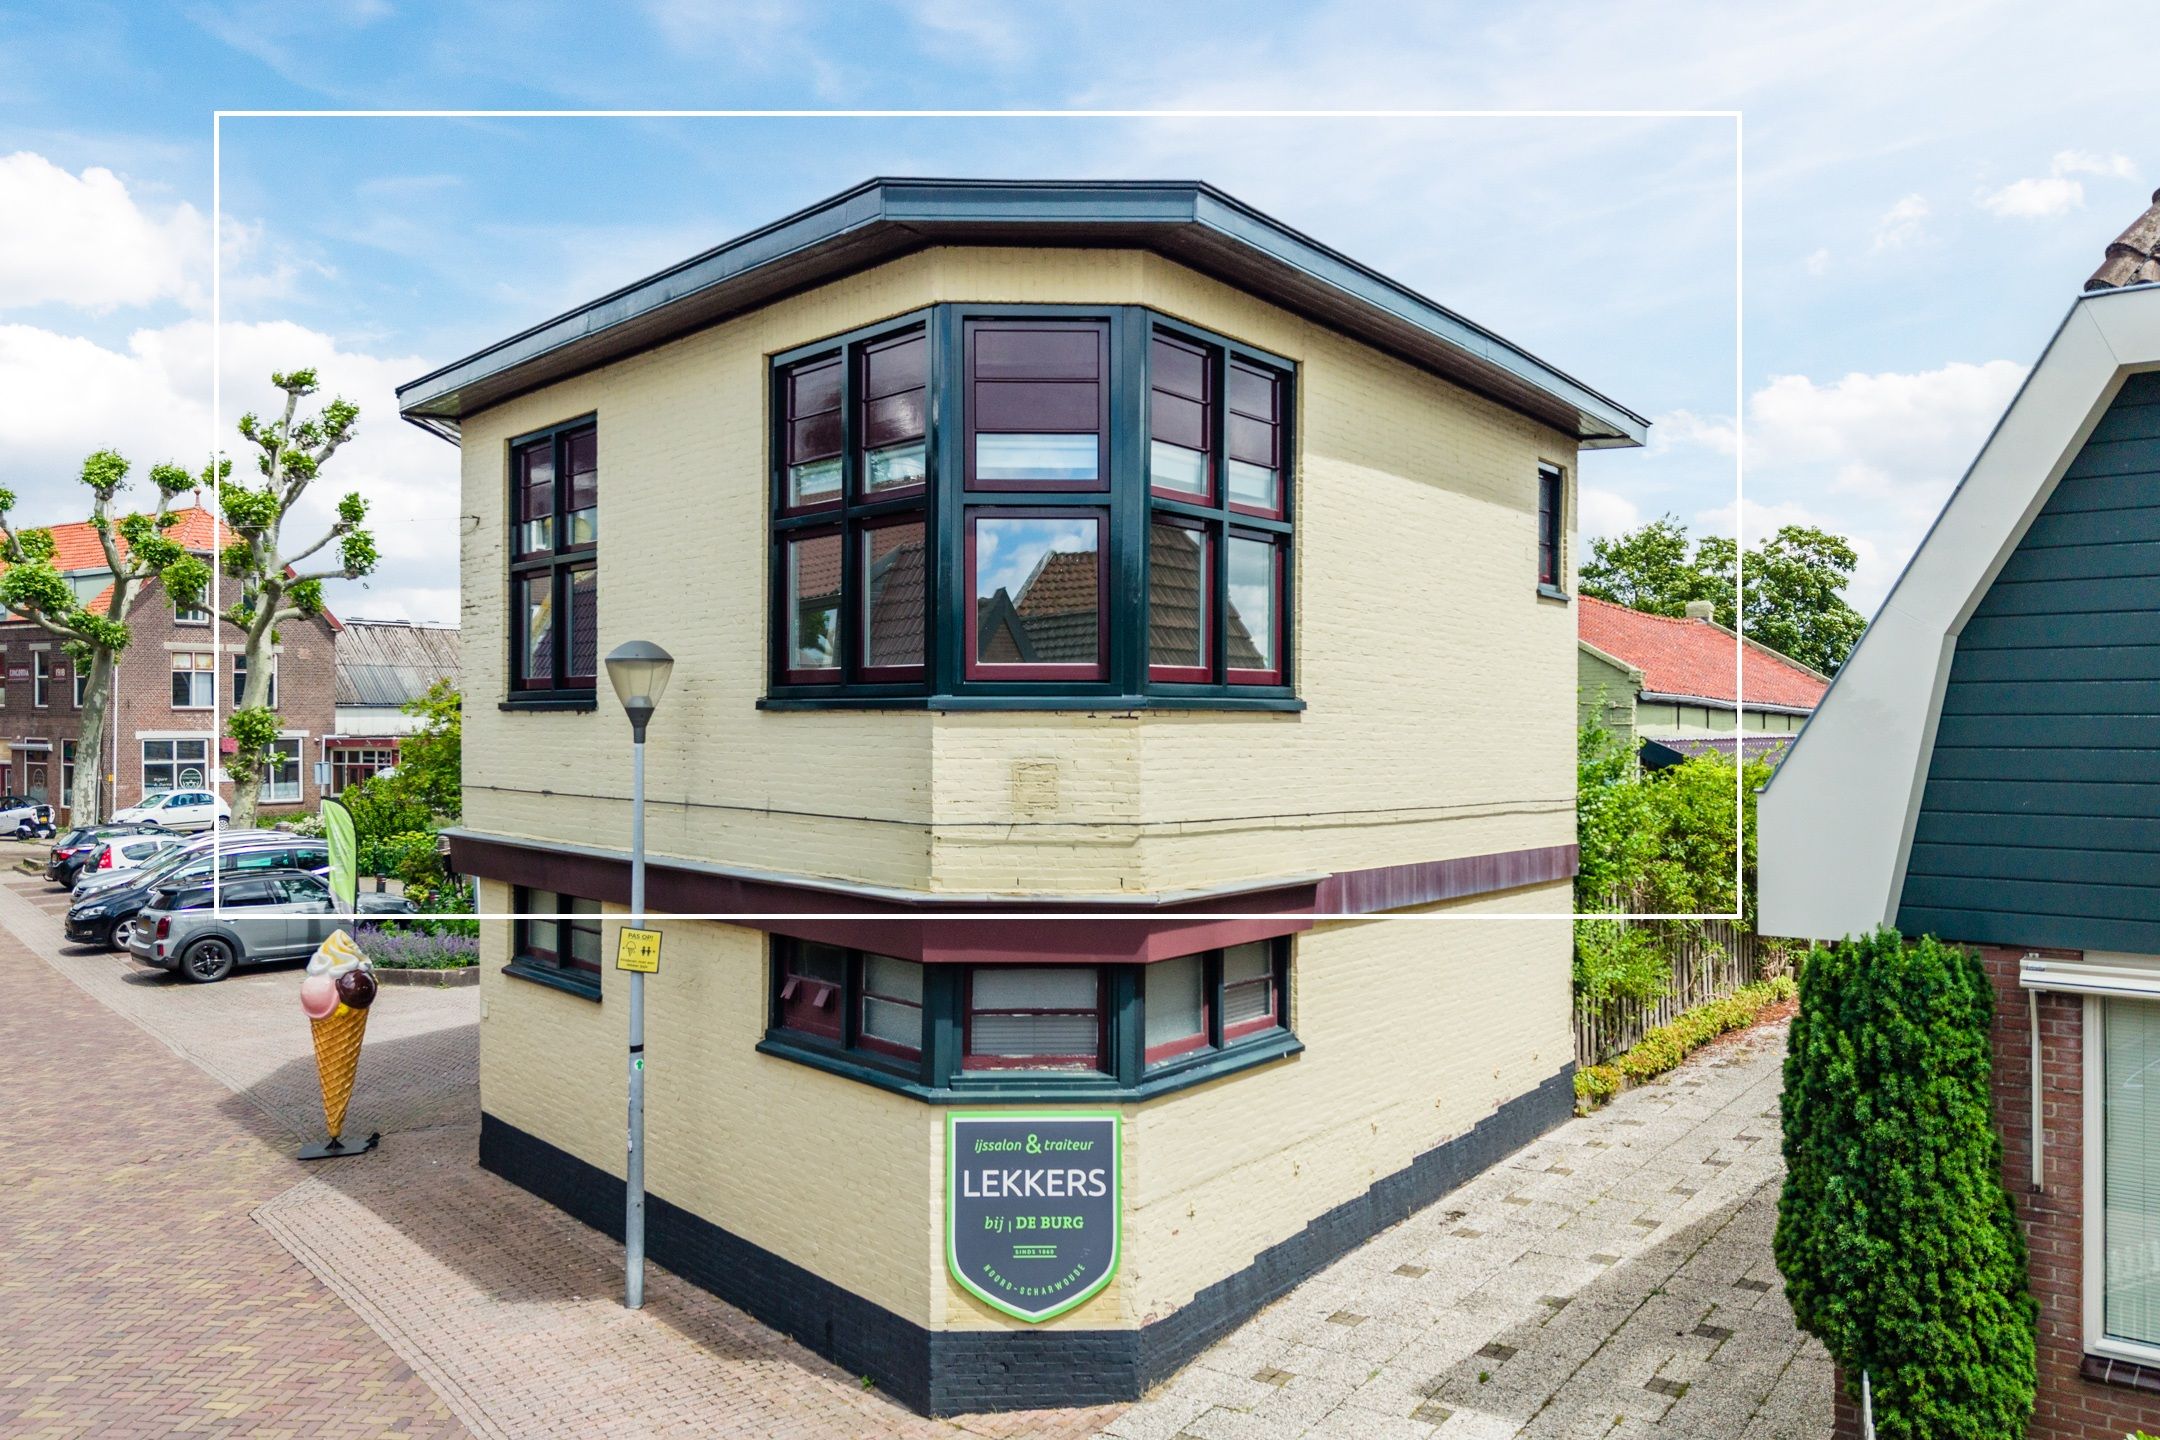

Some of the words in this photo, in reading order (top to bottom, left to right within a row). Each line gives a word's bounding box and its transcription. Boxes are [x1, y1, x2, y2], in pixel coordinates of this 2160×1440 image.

[628, 932, 640, 940] PAS
[975, 1139, 1022, 1154] ijssalon
[1026, 1133, 1042, 1154] &
[1044, 1139, 1094, 1151] traiteur
[963, 1168, 1107, 1198] LEKKERS
[984, 1216, 1004, 1233] bij
[1016, 1216, 1037, 1229] DE
[1040, 1216, 1084, 1229] BURG
[983, 1264, 1086, 1296] NOORD-SCHARWOUDE
